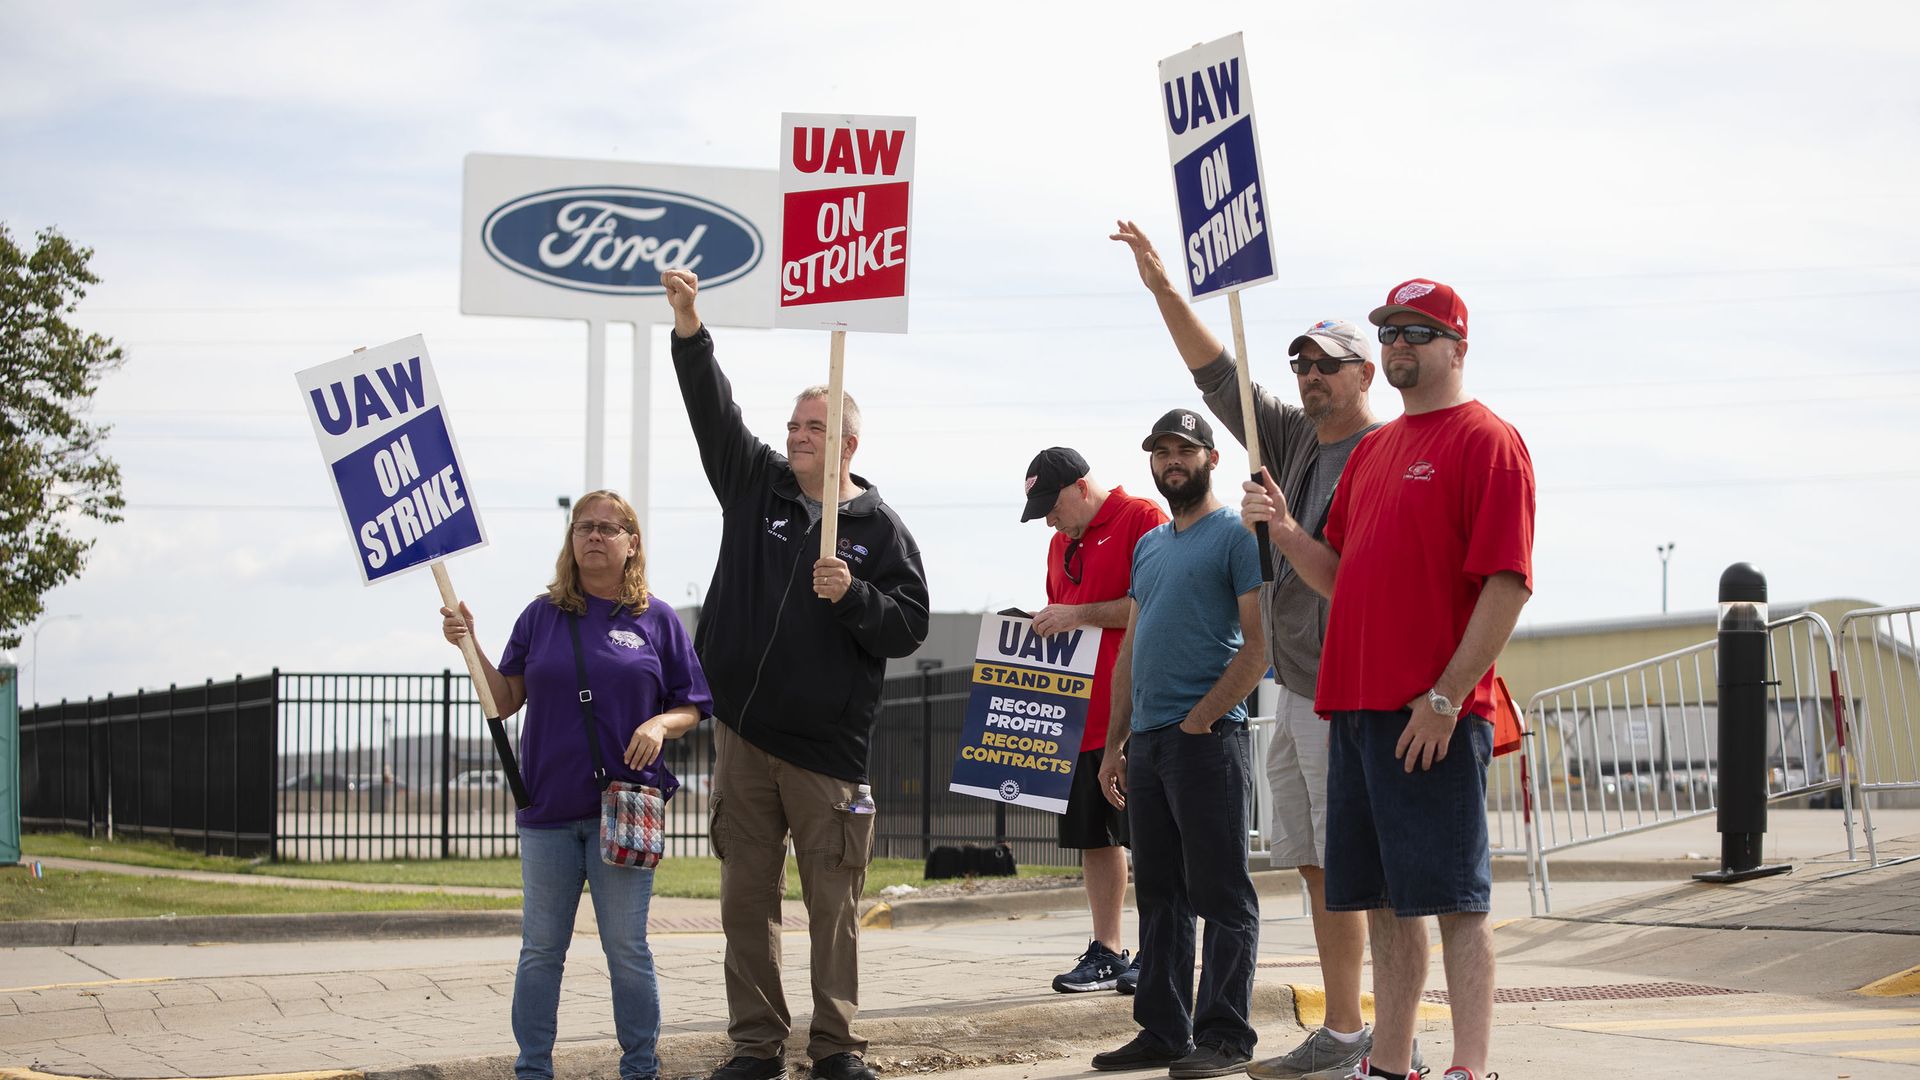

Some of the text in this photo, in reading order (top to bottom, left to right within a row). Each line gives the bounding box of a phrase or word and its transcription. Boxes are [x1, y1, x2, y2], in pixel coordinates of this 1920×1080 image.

[1164, 57, 1240, 135] UAW
[793, 126, 905, 176] UAW
[1200, 142, 1232, 211] ON
[538, 200, 708, 271] Ford
[816, 191, 866, 243] ON
[1188, 182, 1263, 286] STRIKE
[782, 225, 907, 301] STRIKE
[310, 356, 425, 436] UAW
[373, 433, 421, 498] ON
[360, 464, 465, 569] STRIKE
[998, 620, 1083, 667] UAW
[980, 667, 1085, 694] STAND UP
[989, 696, 1066, 719] RECORD
[981, 731, 1059, 755] RECORD
[985, 713, 1064, 737] PROFITS
[961, 746, 1072, 774] CONTRACTS
